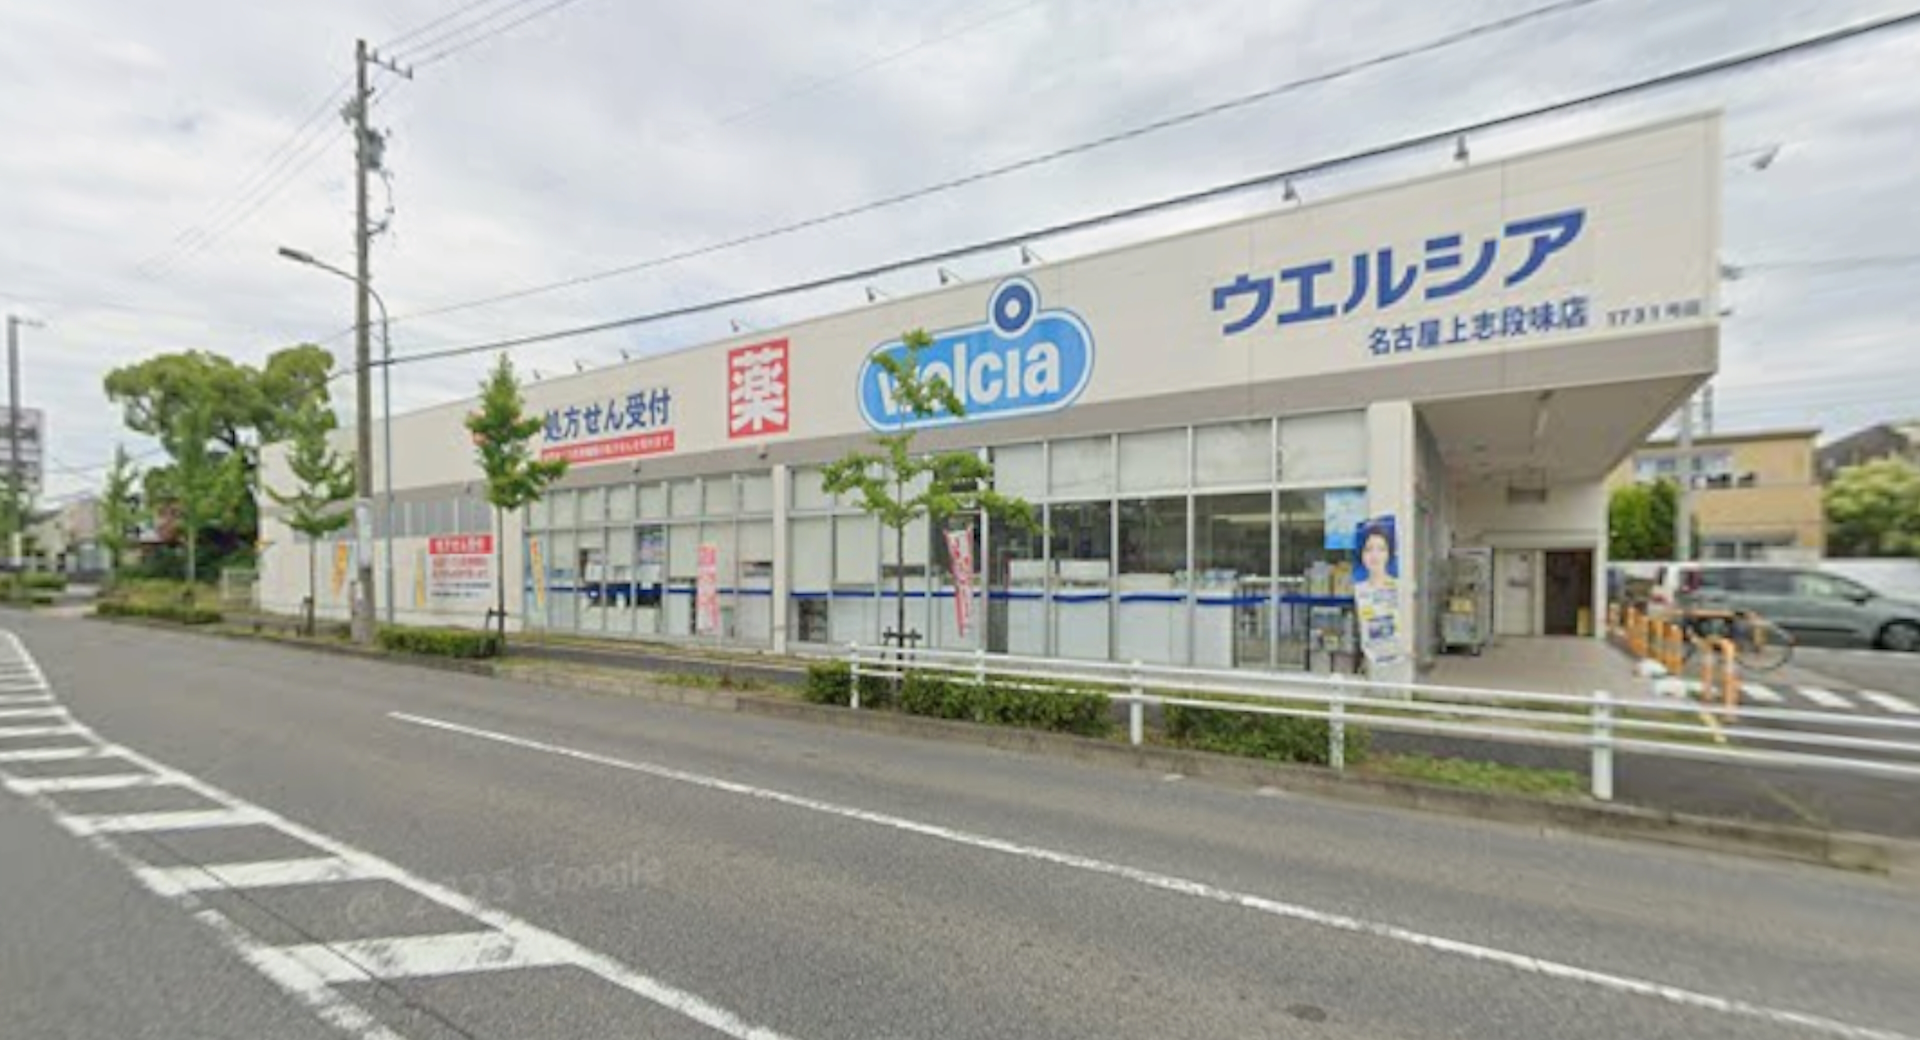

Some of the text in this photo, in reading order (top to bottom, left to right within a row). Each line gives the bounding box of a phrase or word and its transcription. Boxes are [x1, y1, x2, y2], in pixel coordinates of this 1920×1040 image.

[1212, 209, 1586, 335] ウエルシア
[1368, 297, 1588, 355] 名古屋上志段味店
[543, 387, 672, 442] 処方せん受付
[731, 348, 787, 430] 薬
